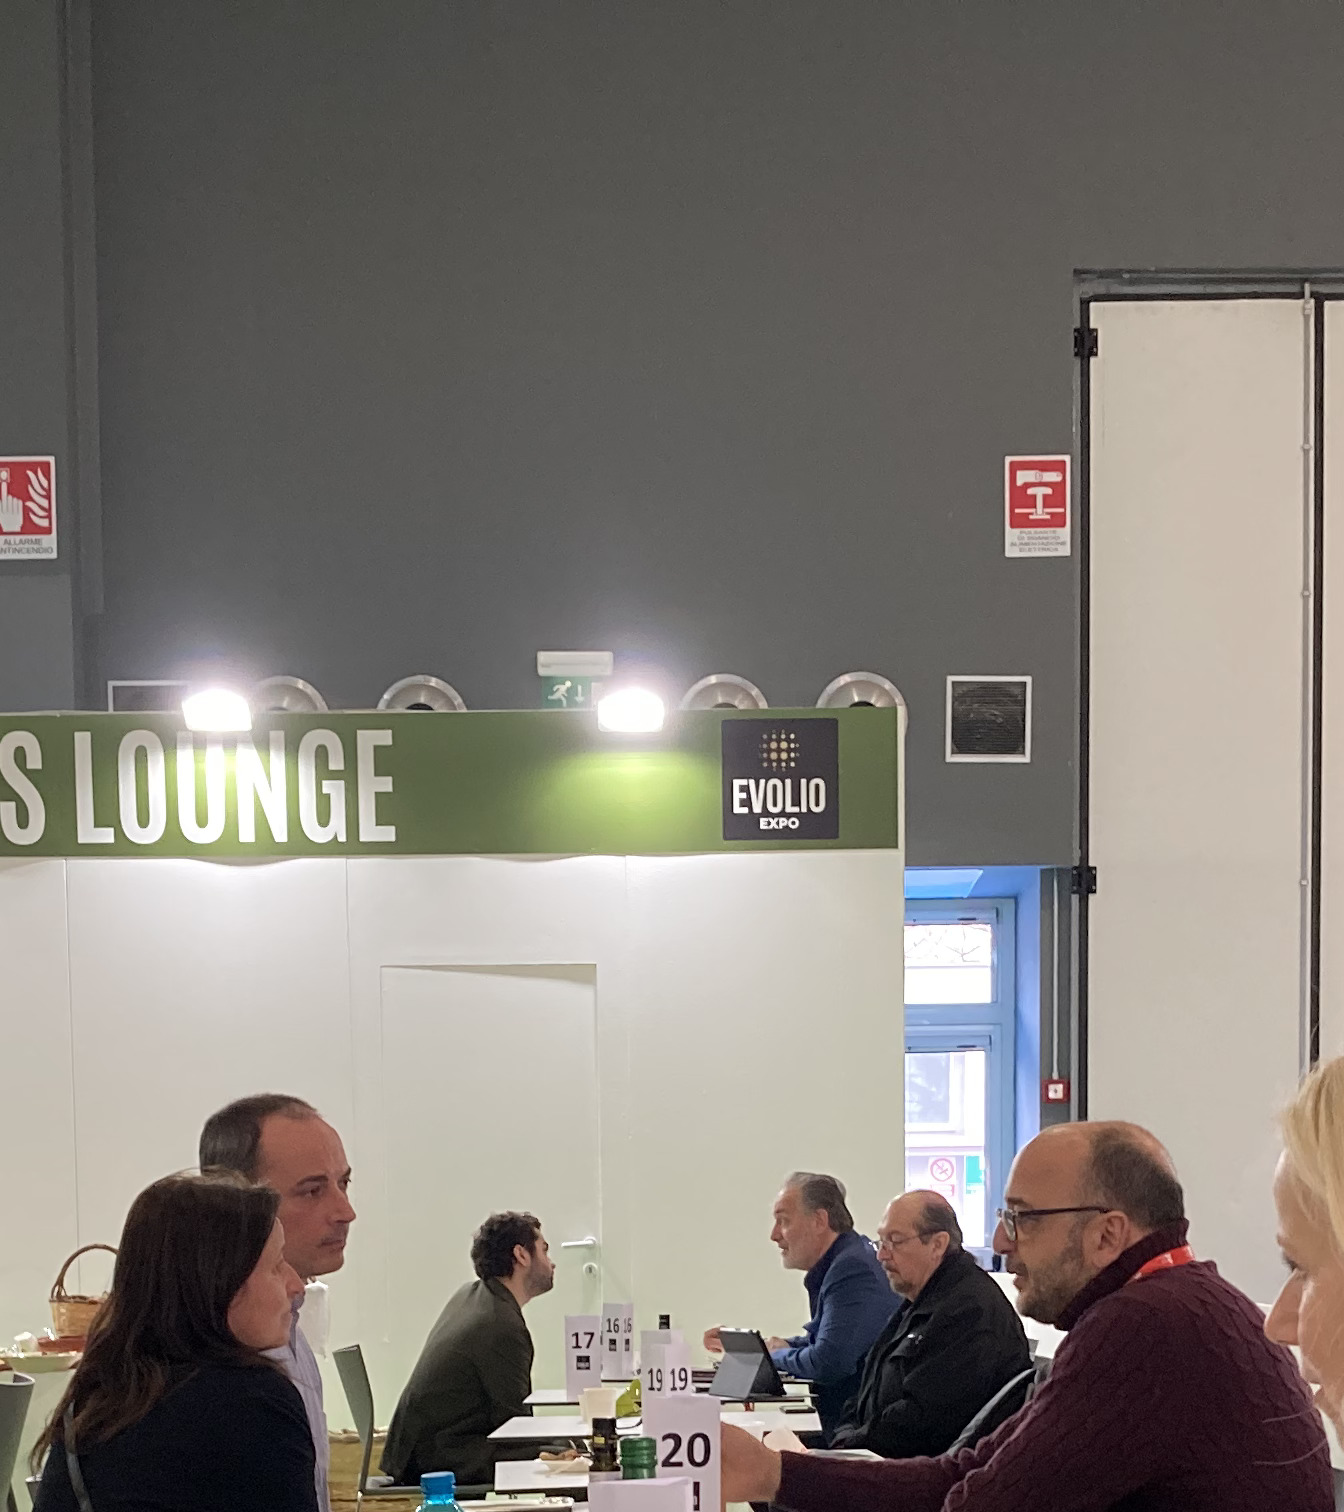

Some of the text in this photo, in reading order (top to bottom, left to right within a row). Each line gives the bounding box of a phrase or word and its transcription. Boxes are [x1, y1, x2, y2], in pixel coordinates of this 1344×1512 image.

[73, 728, 396, 845] LOUNGE
[732, 778, 826, 814] EVOLIO
[760, 817, 800, 829] EXPO
[606, 1317, 620, 1333] 16
[571, 1332, 595, 1349] 17
[647, 1367, 688, 1391] 19 19
[660, 1432, 712, 1468] 20
